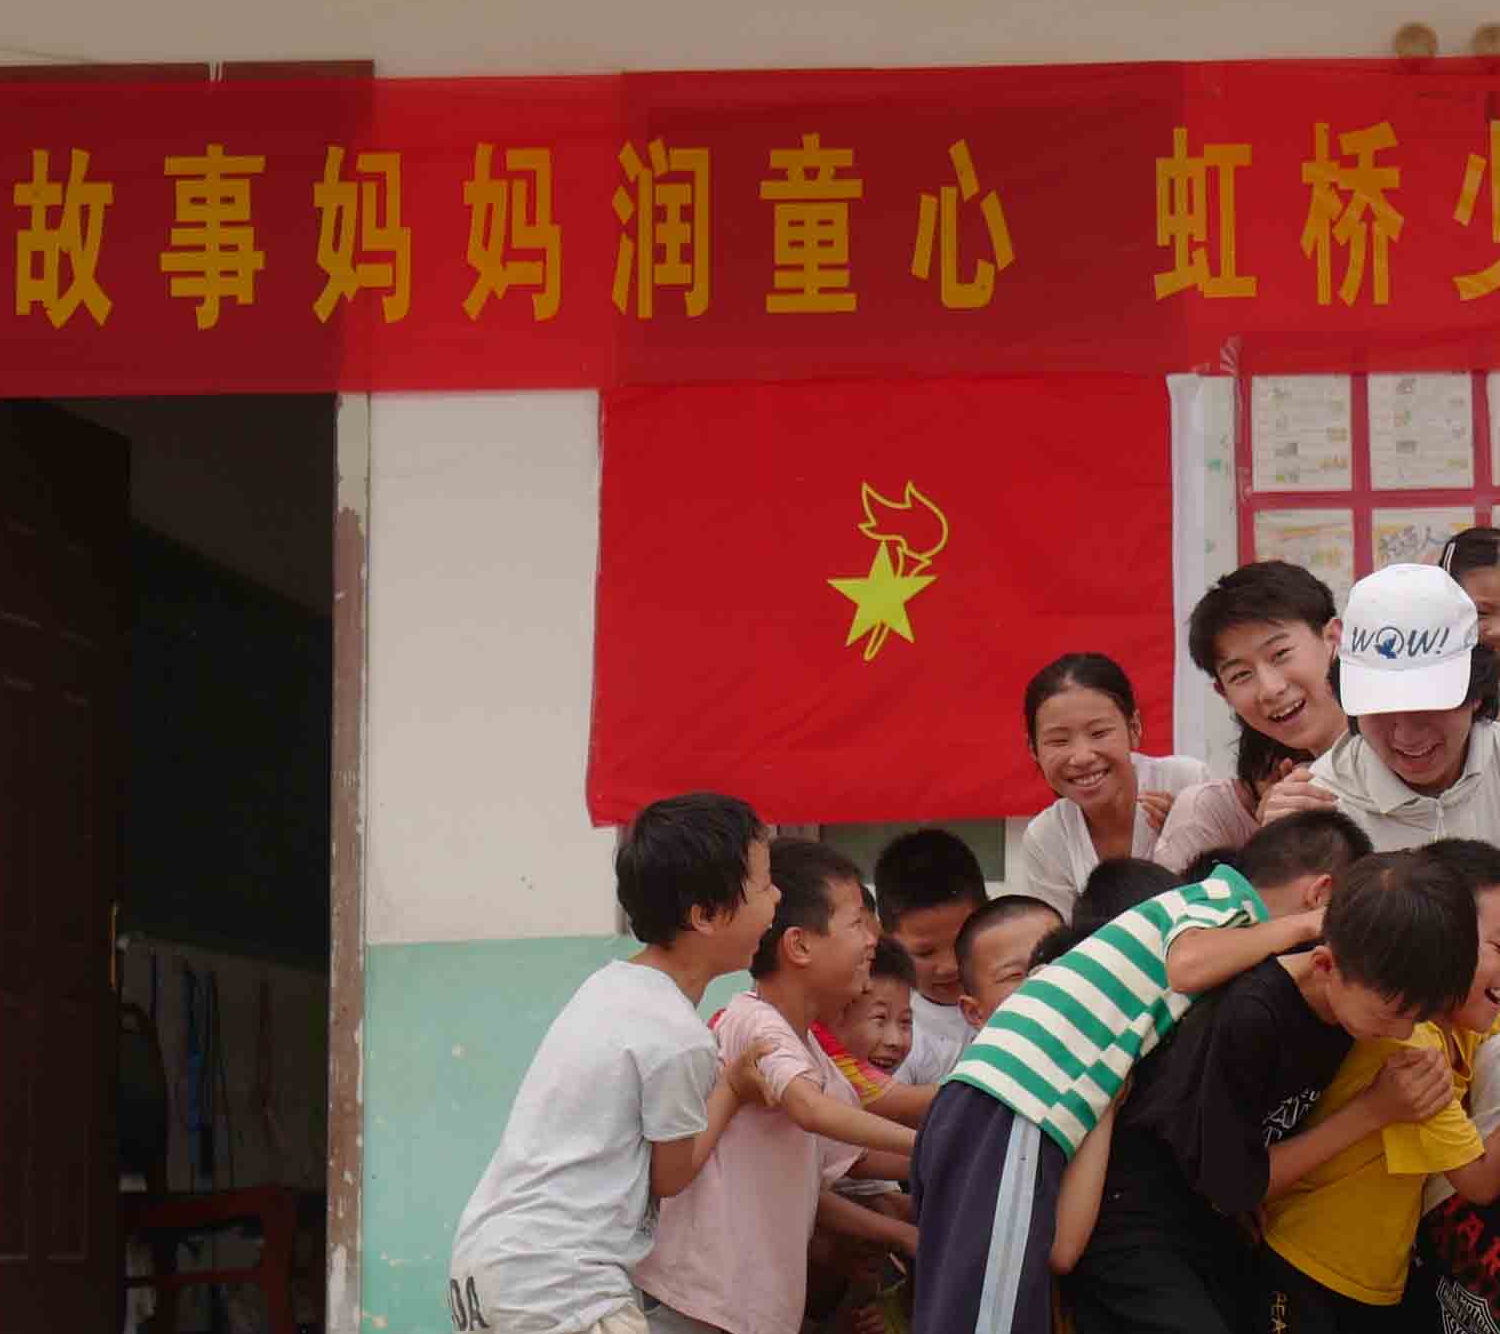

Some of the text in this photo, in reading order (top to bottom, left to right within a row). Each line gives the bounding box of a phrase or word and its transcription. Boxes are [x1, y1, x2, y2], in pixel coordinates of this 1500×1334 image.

[13, 133, 1016, 330] 故事妈妈润童心
[1351, 626, 1450, 658] WOW!
